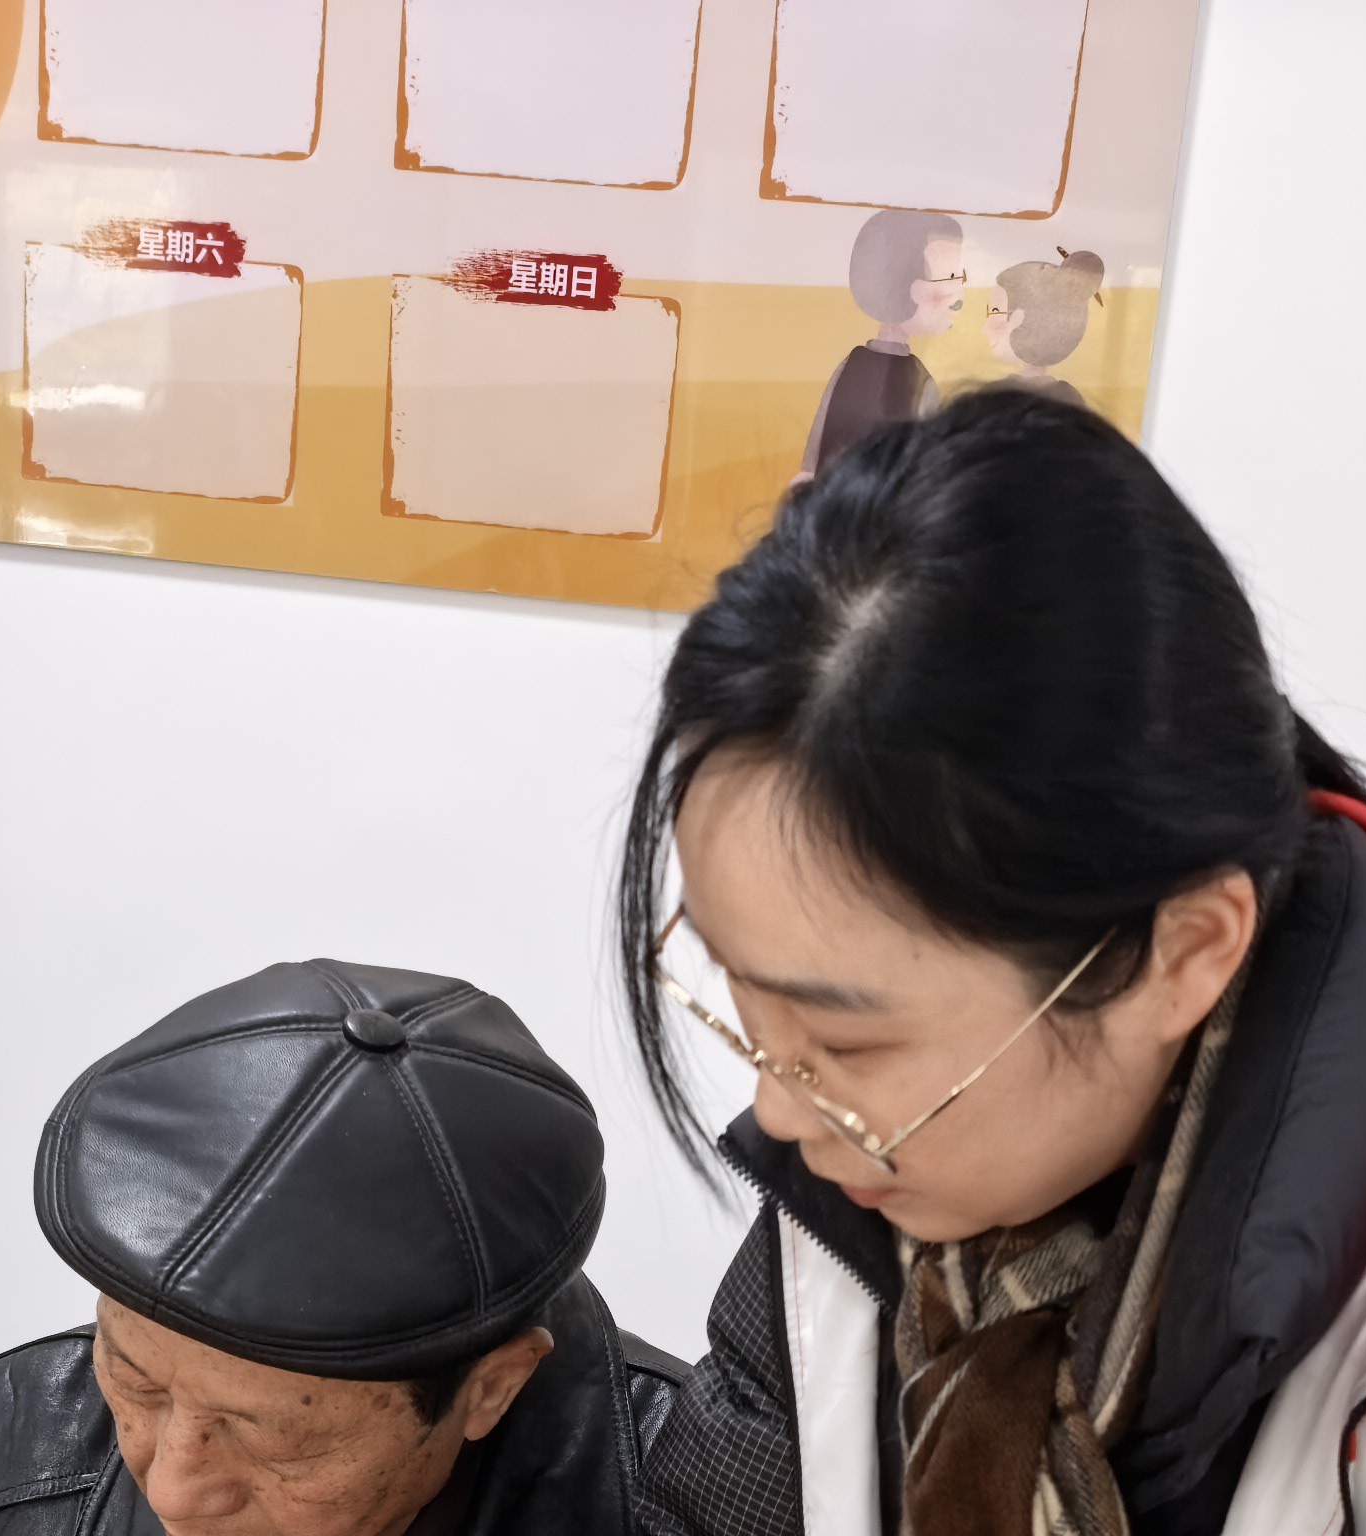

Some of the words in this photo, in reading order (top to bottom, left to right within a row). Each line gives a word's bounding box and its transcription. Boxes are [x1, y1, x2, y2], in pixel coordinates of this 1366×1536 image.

[135, 227, 226, 266] 星期六
[507, 260, 598, 299] 星期日
